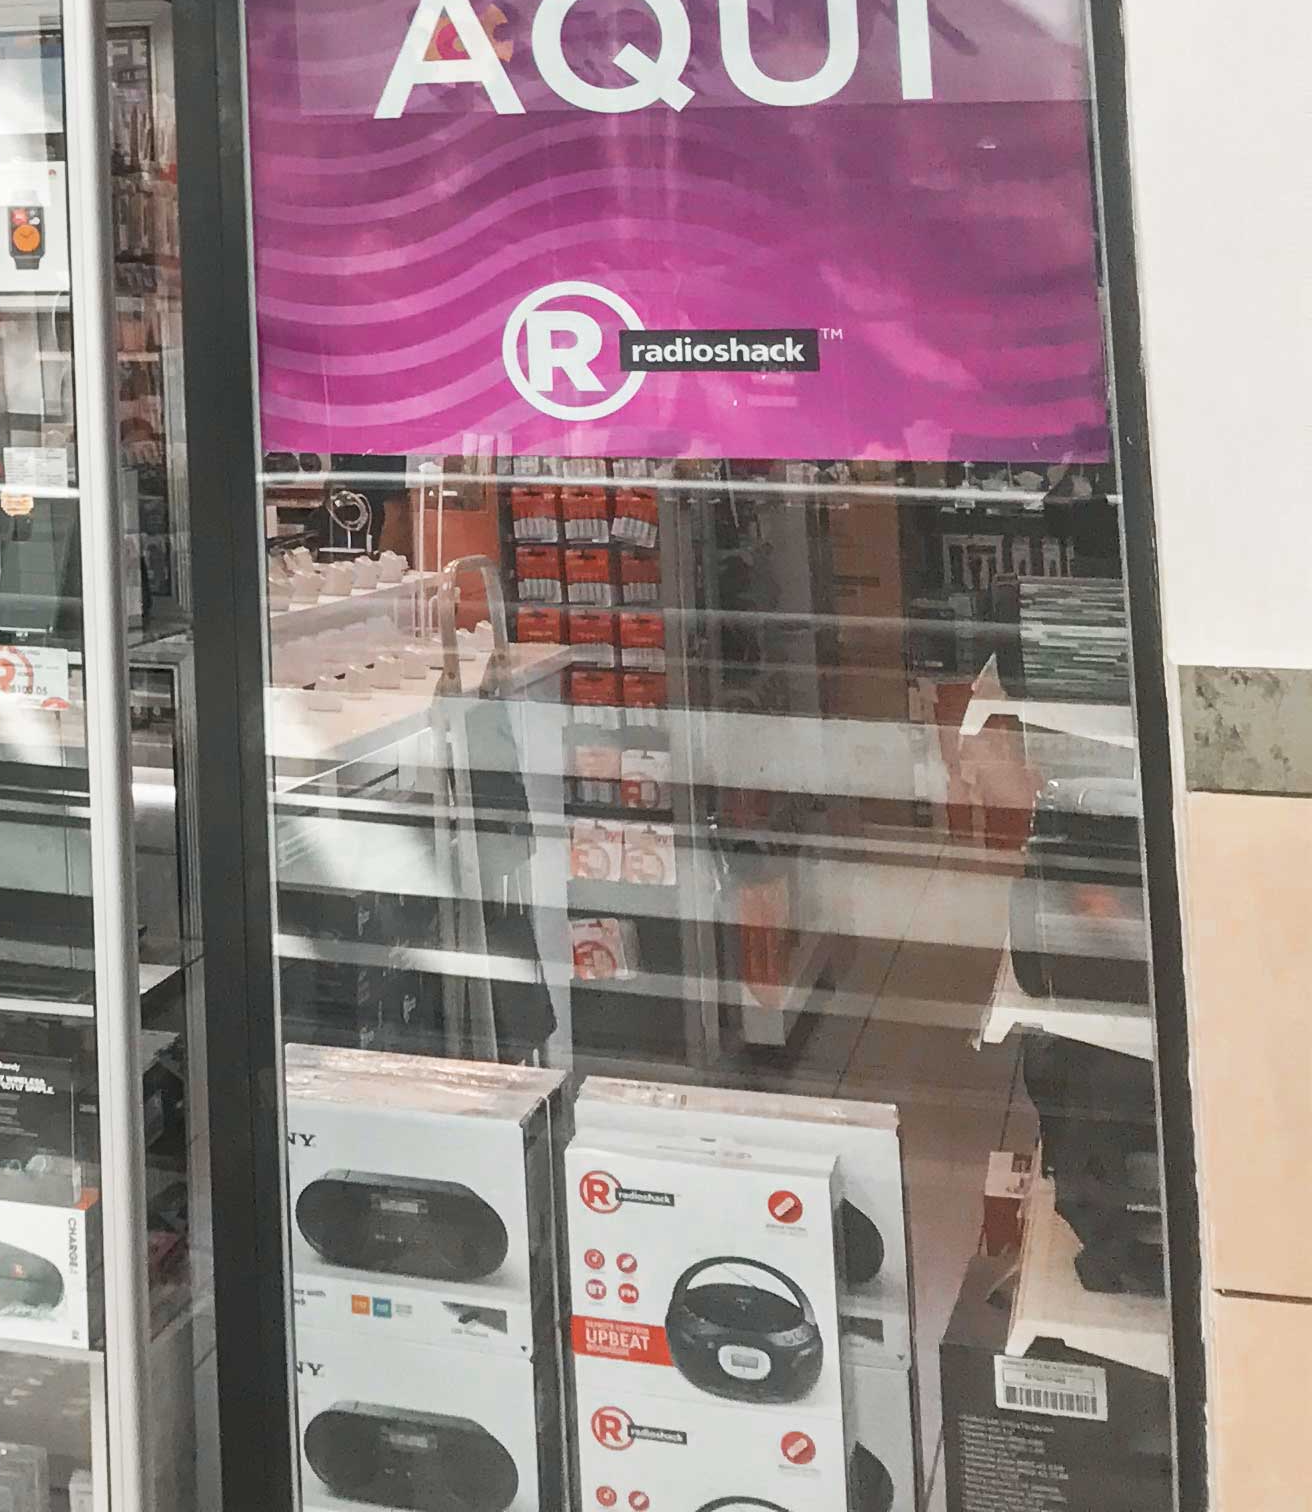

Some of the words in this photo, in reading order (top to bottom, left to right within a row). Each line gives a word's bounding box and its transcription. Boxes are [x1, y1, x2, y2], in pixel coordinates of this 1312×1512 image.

[630, 333, 807, 368] radioshack
[617, 1190, 672, 1206] radioshack
[620, 1288, 638, 1300] FM
[585, 1327, 651, 1352] UPBEAT
